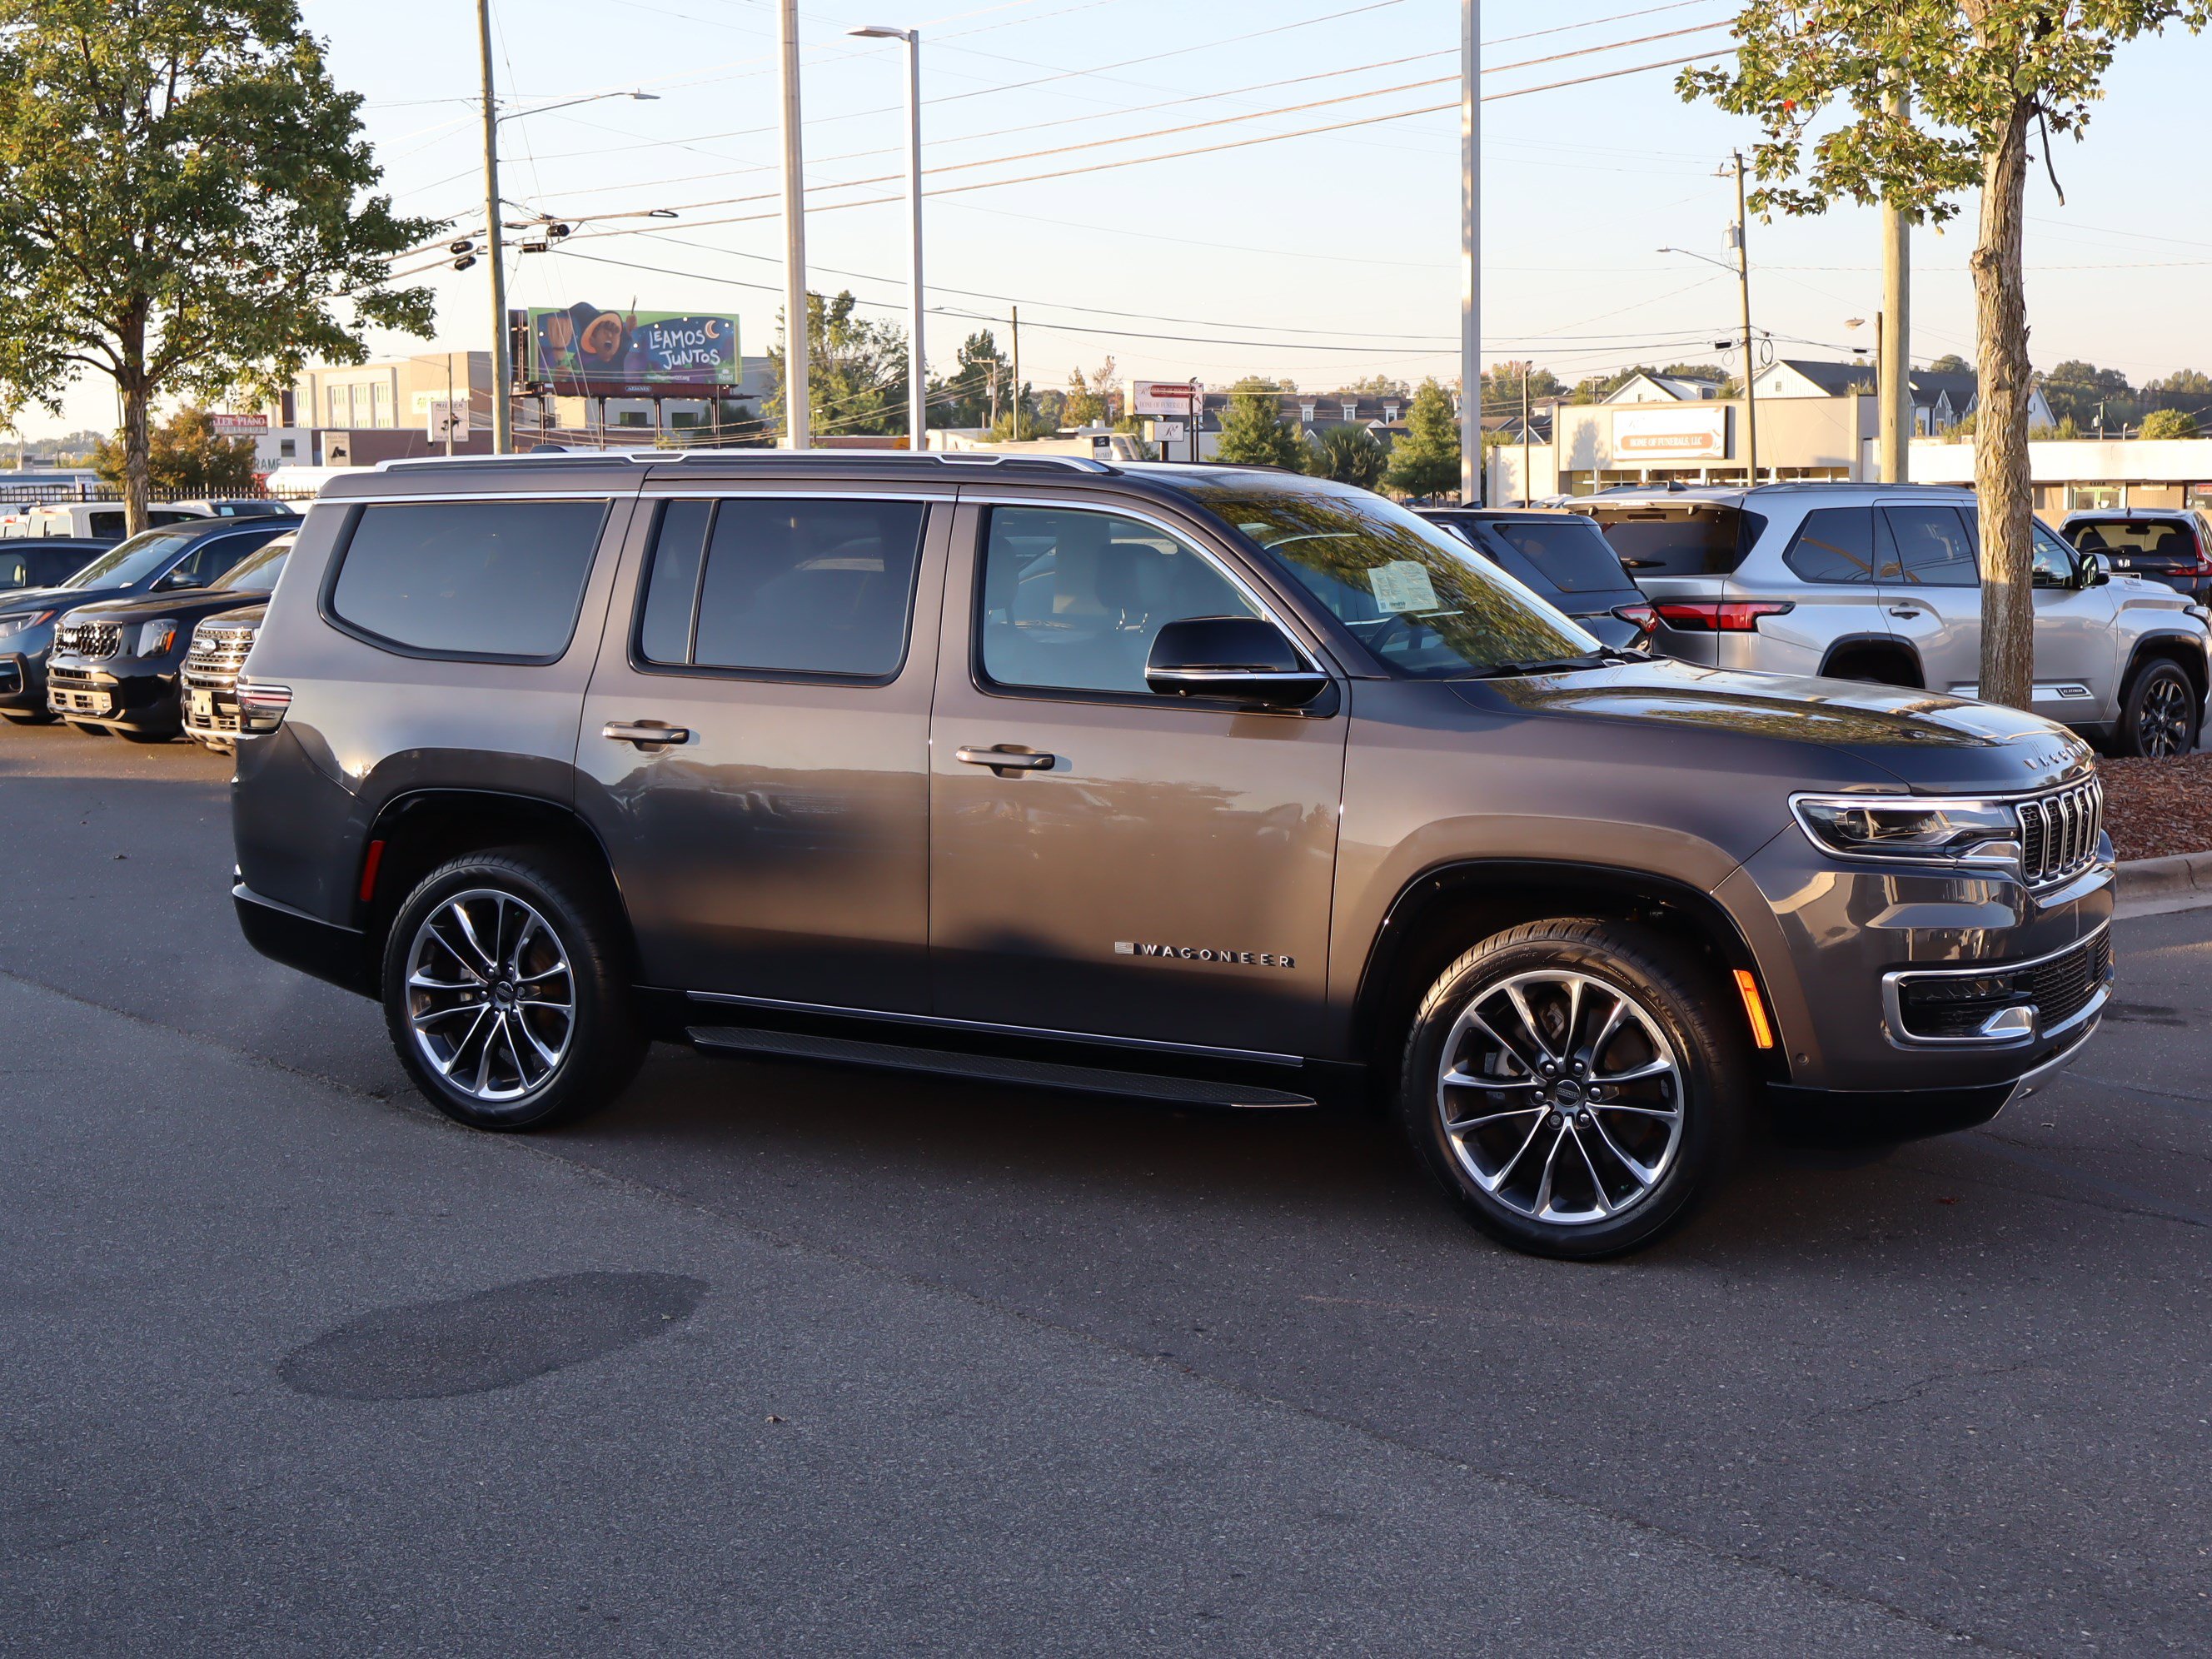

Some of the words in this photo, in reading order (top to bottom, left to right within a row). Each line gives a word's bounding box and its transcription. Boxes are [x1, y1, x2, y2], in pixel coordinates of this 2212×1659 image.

[650, 330, 705, 349] LEAMOS
[659, 348, 721, 370] JUNTOS
[237, 416, 265, 426] PIANO
[1648, 438, 1657, 446] OF
[1691, 436, 1702, 446] LLC
[1142, 944, 1290, 968] WAGONEER
